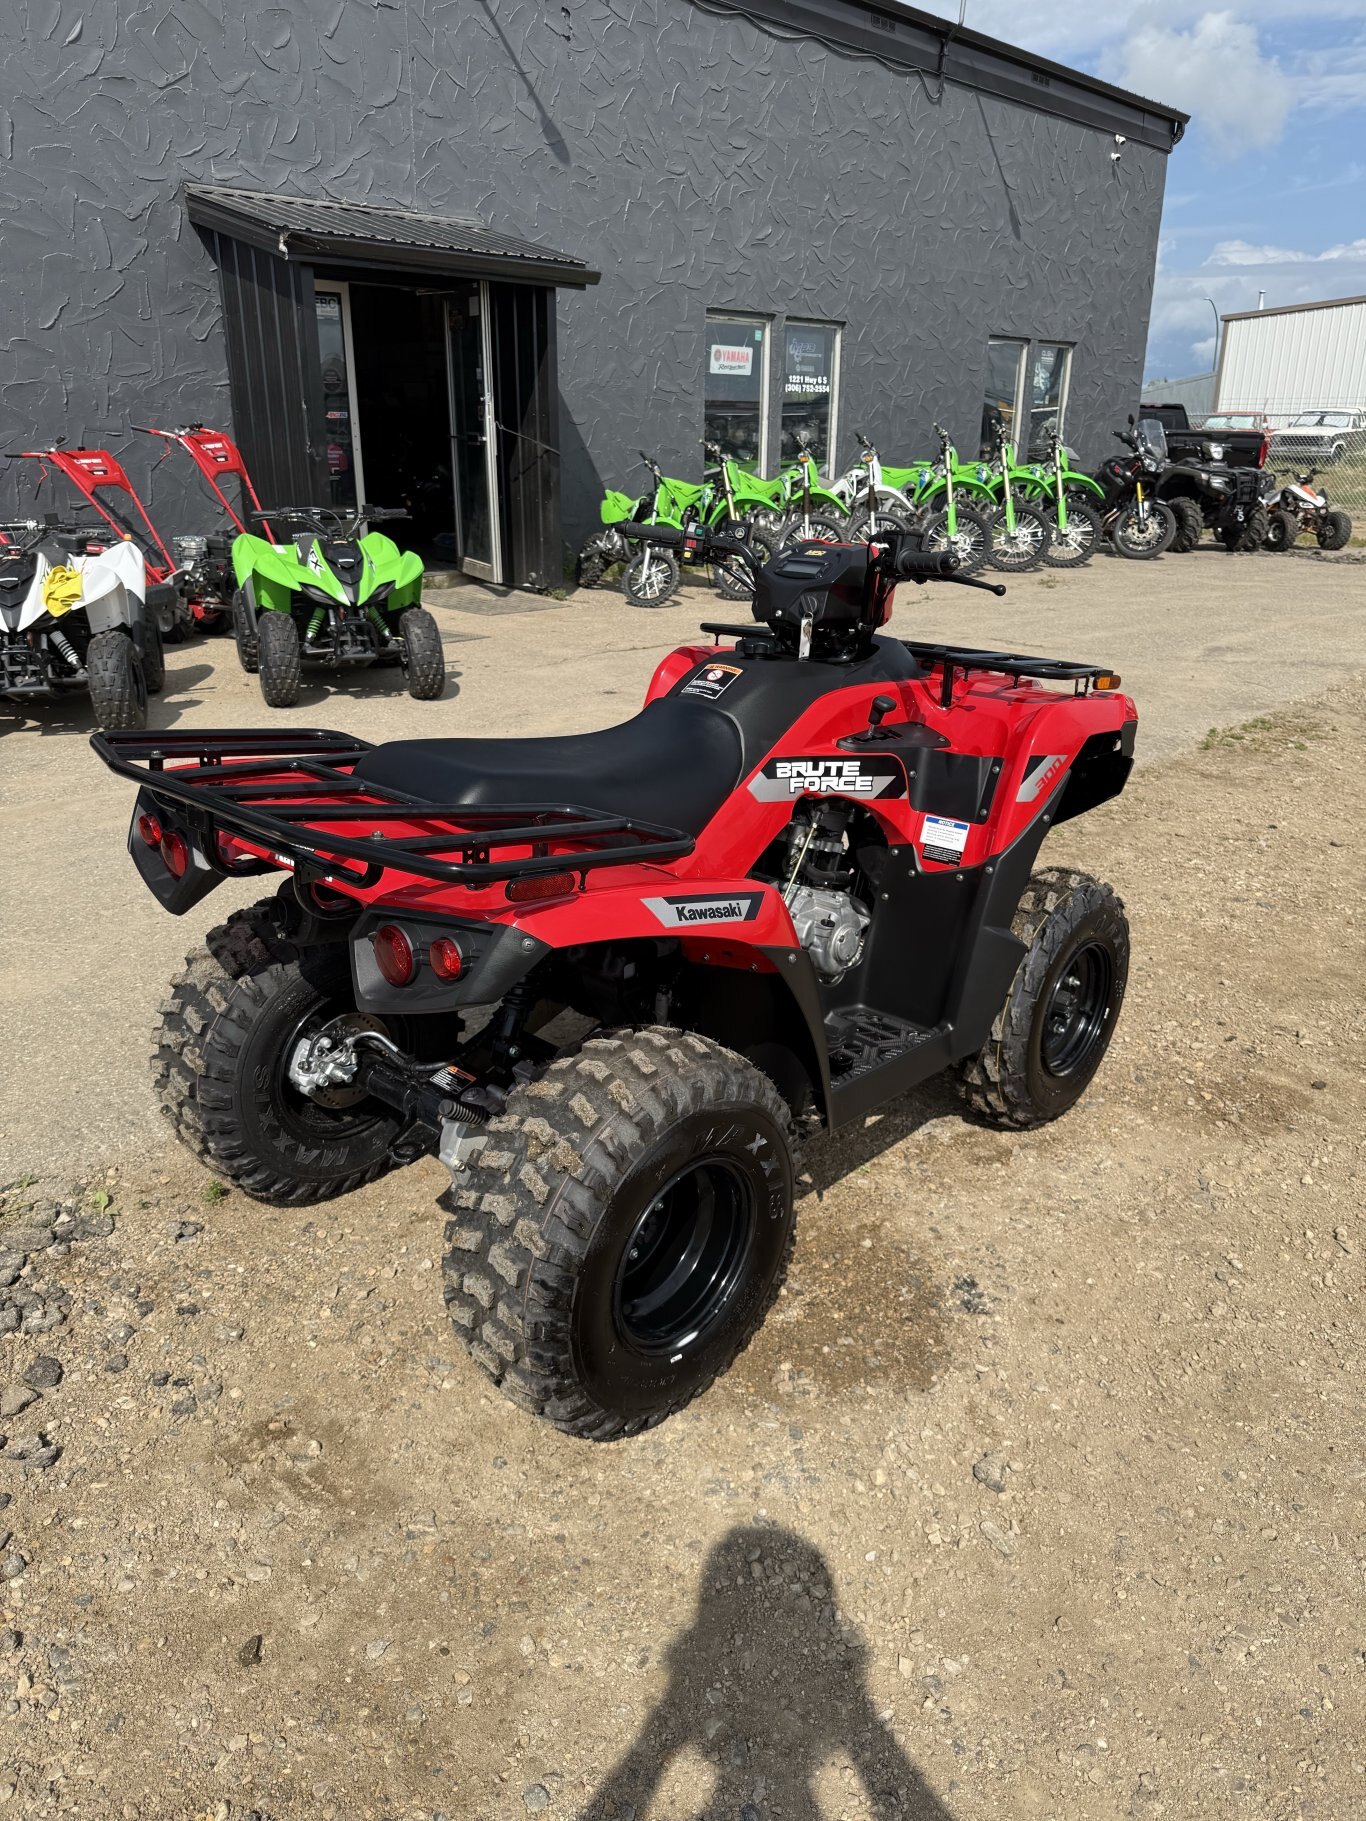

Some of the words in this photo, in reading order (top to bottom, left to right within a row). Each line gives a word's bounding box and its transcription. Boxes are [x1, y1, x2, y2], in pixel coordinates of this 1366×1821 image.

[722, 350, 749, 363] YAMAHA
[789, 374, 804, 384] 1221
[804, 375, 818, 386] Hwy
[785, 384, 801, 393] (306)
[802, 384, 830, 393] 752-2554
[776, 761, 861, 779] BRUTE
[789, 775, 874, 793] FORCE
[938, 819, 956, 828] NOTICE
[676, 902, 743, 922] Kawasaki
[254, 1064, 350, 1167] MAXXIS
